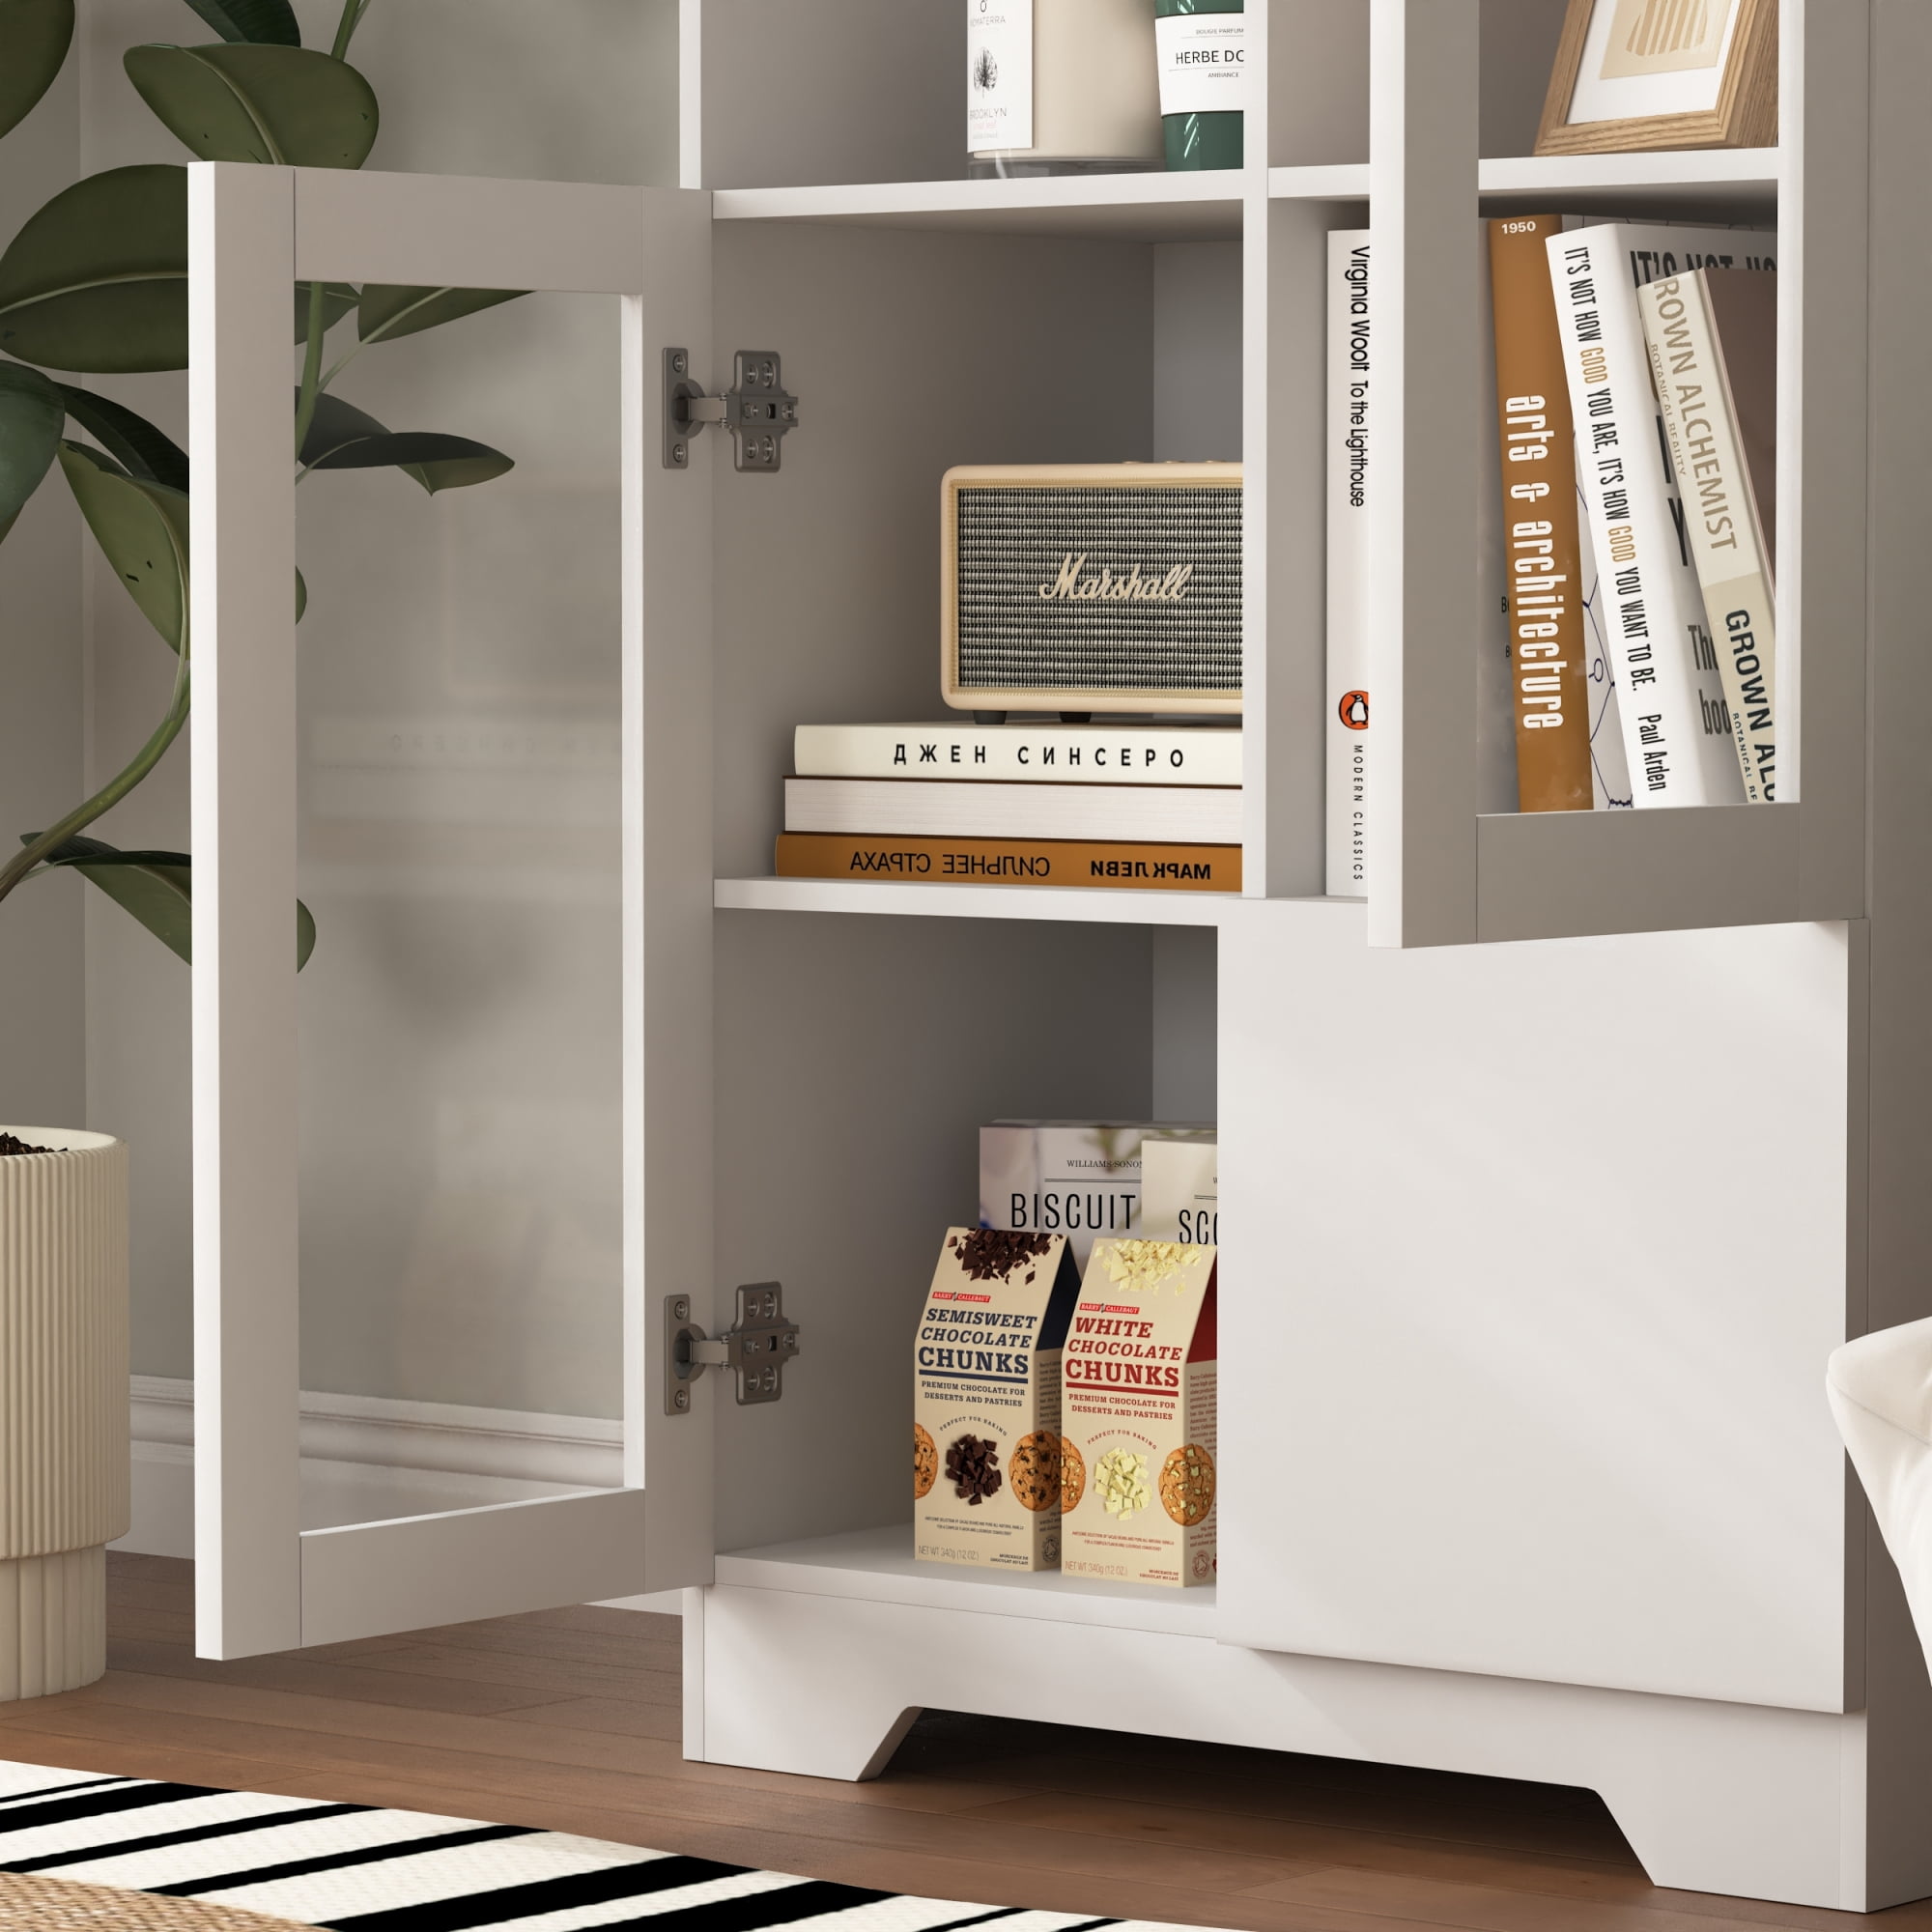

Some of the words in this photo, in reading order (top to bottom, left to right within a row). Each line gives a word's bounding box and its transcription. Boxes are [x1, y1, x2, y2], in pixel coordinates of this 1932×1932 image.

[1176, 50, 1220, 65] HERBE
[1501, 220, 1537, 235] 1950
[1565, 246, 1592, 275] IT'S
[1345, 245, 1370, 315] Virginia
[1570, 278, 1597, 306] NOT
[1575, 310, 1603, 342] HOW
[1579, 347, 1608, 384] GOOD
[1350, 381, 1369, 398] To
[1586, 387, 1614, 417] YOU
[1350, 401, 1369, 425] the
[1653, 277, 1698, 376] ROWN
[1676, 384, 1738, 551] ALCHEMIST
[1505, 394, 1555, 463] arts
[1591, 422, 1619, 454] ARE,
[1345, 429, 1369, 507] Lighthouse
[1597, 458, 1625, 485] IT'S
[1510, 481, 1550, 503] &
[1603, 489, 1631, 521] HOW
[1607, 525, 1636, 562] GOOD
[1038, 552, 1194, 600] Marshall
[1614, 566, 1642, 595] YOU
[1512, 520, 1568, 729] architecture
[1620, 599, 1649, 639] WANT
[1627, 643, 1653, 663] TO
[1630, 668, 1657, 692] BE.
[1725, 609, 1774, 732] GROWN
[1637, 713, 1666, 745] Paul
[894, 744, 986, 766] ДЖЕН
[1016, 746, 1184, 768] СИНСЕРО
[1352, 744, 1364, 803] MODERN
[1643, 751, 1670, 791] Arden
[1352, 811, 1364, 880] CLASSICS
[1011, 1192, 1136, 1230] BISCUIT
[1179, 1208, 1217, 1245] SC
[925, 1308, 1037, 1329] SEMISWEET
[1075, 1317, 1153, 1339] WHITE
[921, 1326, 1033, 1349] CHOCOLATE
[1068, 1339, 1183, 1361] CHOCOLATE
[918, 1347, 1029, 1375] CHUNKS
[1065, 1358, 1179, 1387] CHUNKS
[922, 1380, 959, 1390] PREMIUM
[960, 1384, 1008, 1395] CHOCOLATE
[924, 1392, 964, 1402] DESSERTS
[966, 1395, 983, 1404] AND
[984, 1397, 1022, 1407] PASTRIES
[1068, 1393, 1107, 1404] PREMIUM
[1109, 1397, 1158, 1407] CHOCOLATE
[1159, 1401, 1176, 1409] FOR
[1071, 1405, 1112, 1415] DESSERTS
[1114, 1408, 1132, 1417] AND
[1133, 1410, 1173, 1421] PASTRIES
[918, 1545, 929, 1554] NET
[1065, 1561, 1076, 1570] NET
